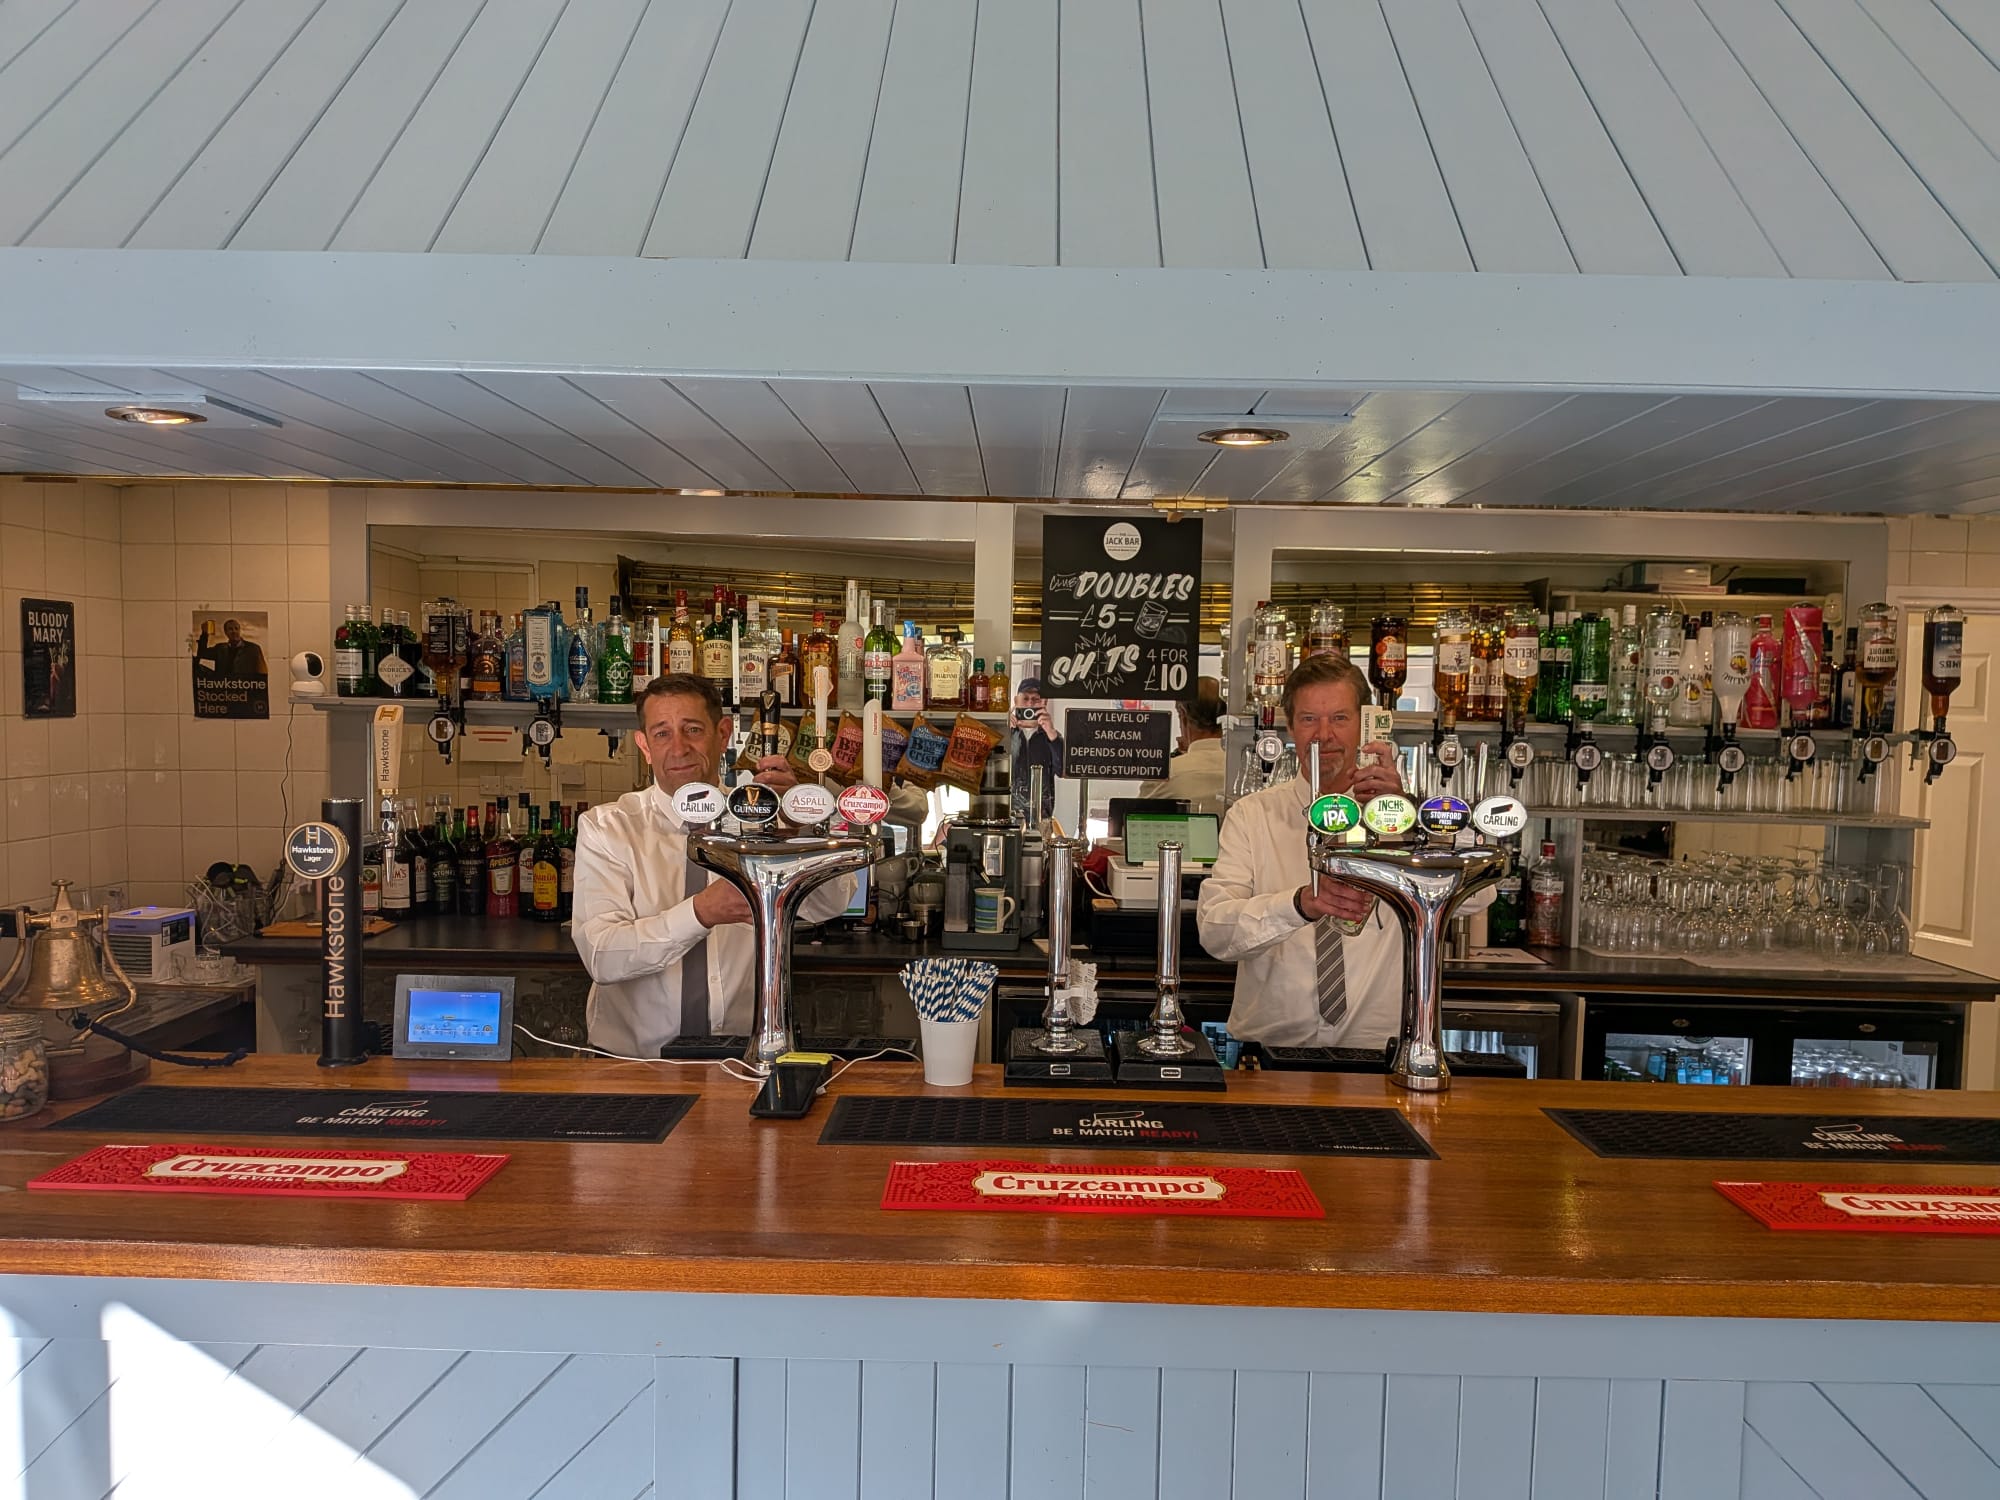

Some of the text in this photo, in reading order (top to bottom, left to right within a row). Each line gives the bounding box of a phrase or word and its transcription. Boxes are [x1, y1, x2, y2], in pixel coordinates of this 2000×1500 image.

[1106, 537, 1123, 545] JACK
[1075, 571, 1194, 600] DOUBLES
[28, 611, 68, 628] BLOODY
[1080, 603, 1118, 629] £5
[33, 627, 64, 643] MARY
[1147, 649, 1188, 662] 4 FOR
[1506, 648, 1538, 658] BELL'S
[196, 678, 266, 689] Hawkstone
[1144, 664, 1188, 692] £10
[198, 690, 248, 702] Stocked
[198, 702, 227, 714] Here
[1088, 712, 1150, 723] MY LEVEL OF
[1094, 730, 1142, 740] SARCASM
[380, 729, 390, 782] Hawkstone
[1070, 747, 1163, 759] DEPENDS ON YOUR
[1070, 765, 1098, 774] LEVEL
[792, 794, 827, 806] ASPALL
[843, 800, 884, 810] Cruzcampo
[680, 802, 716, 812] CARLING
[734, 804, 772, 814] GUINNESS
[1378, 799, 1404, 813] INCH'S
[1322, 810, 1349, 827] IPA
[1430, 812, 1462, 820] STOWFORD
[1484, 814, 1518, 827] CARLING
[292, 846, 334, 854] Hawkstone
[382, 868, 406, 878] PM'S
[324, 876, 345, 1018] Hawkstone
[338, 1108, 429, 1118] CARLING
[296, 1116, 322, 1124] BE
[324, 1117, 384, 1125] MATCH
[1079, 1119, 1164, 1128] CARLING
[1053, 1128, 1199, 1138] BE MATCH READY!
[1812, 1132, 1904, 1142] CARLING
[1828, 1142, 1890, 1150] MATCH
[170, 1158, 386, 1178] Cruzcampo
[228, 1174, 294, 1182] SEVILLA
[993, 1176, 1205, 1195] Cruzcampo
